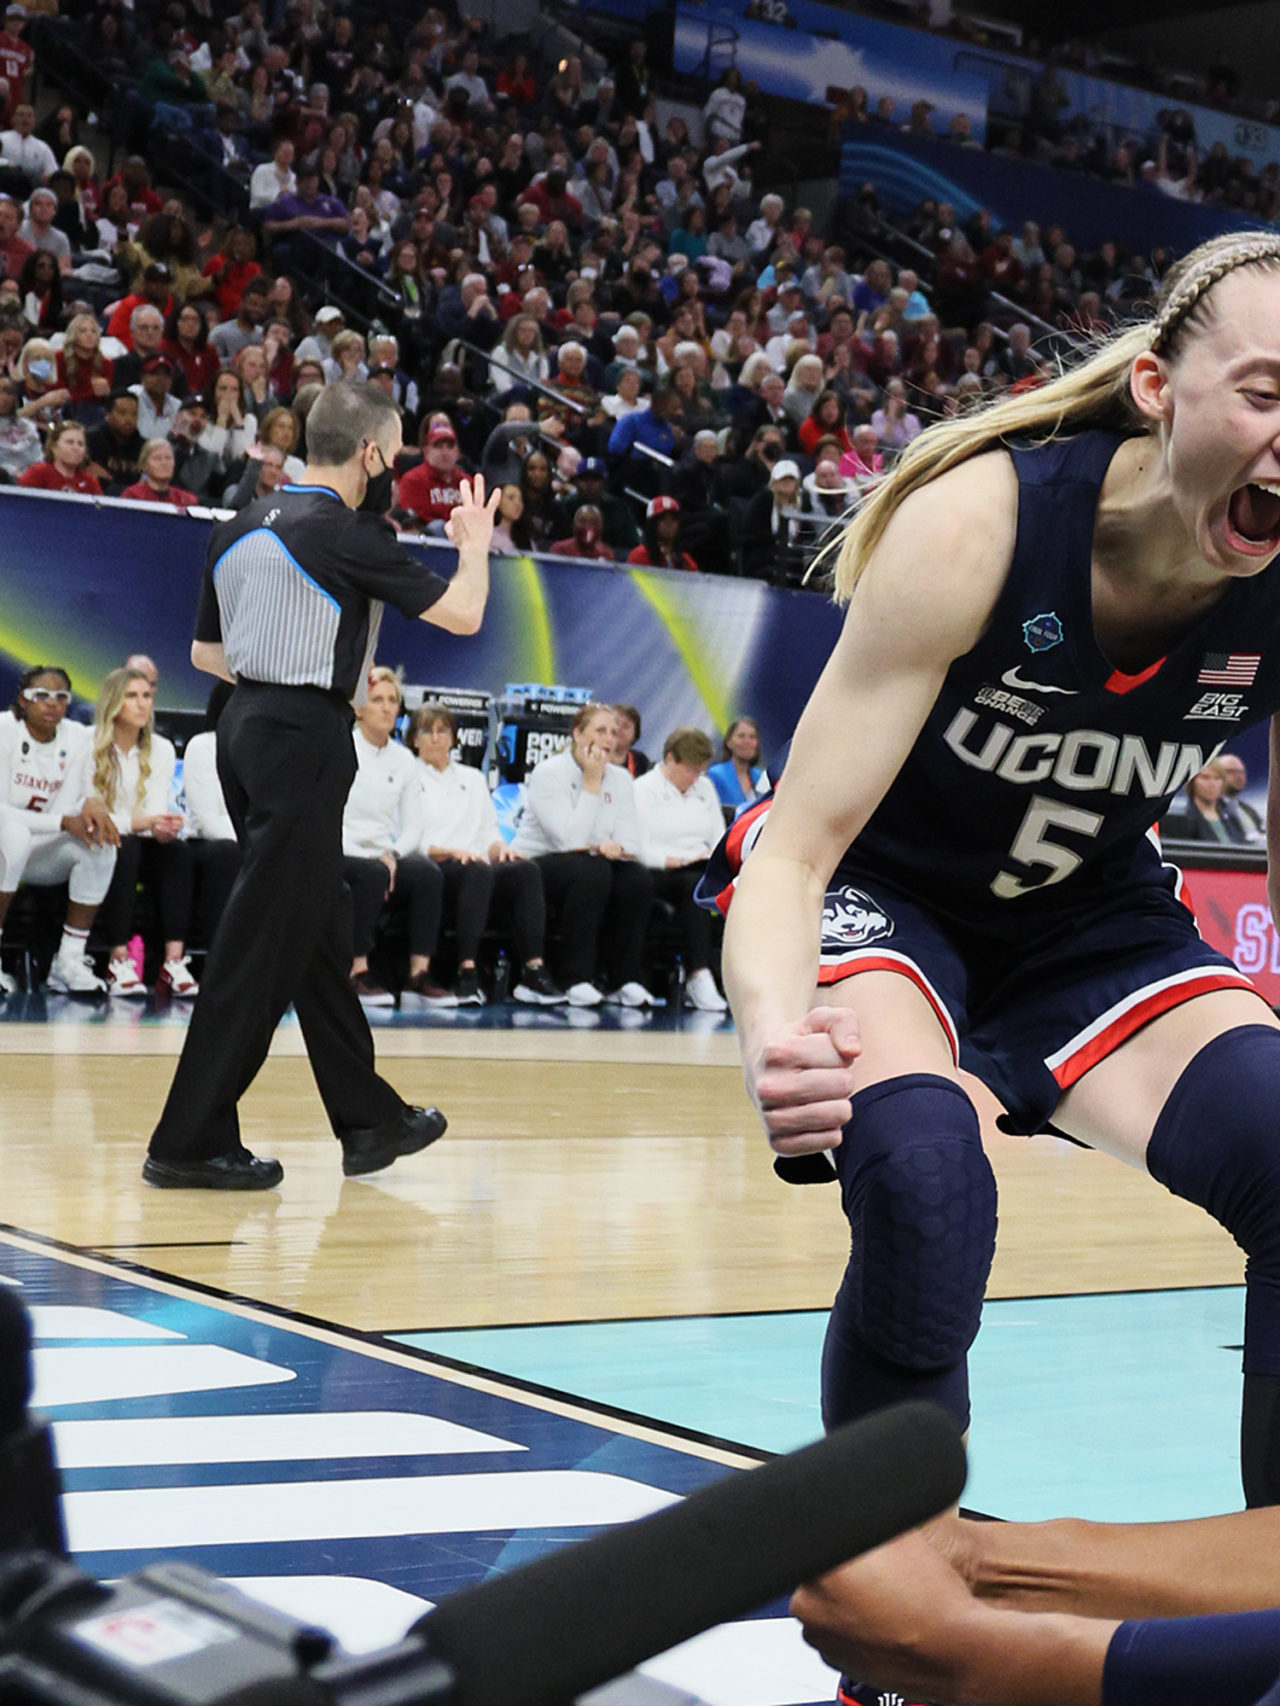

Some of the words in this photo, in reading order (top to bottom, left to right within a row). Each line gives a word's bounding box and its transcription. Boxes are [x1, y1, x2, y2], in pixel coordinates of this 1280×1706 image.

[1189, 703, 1249, 717] EAST
[1199, 692, 1244, 706] BIG
[527, 731, 573, 753] POW
[943, 707, 1228, 798] UCONN
[990, 794, 1105, 899] 5
